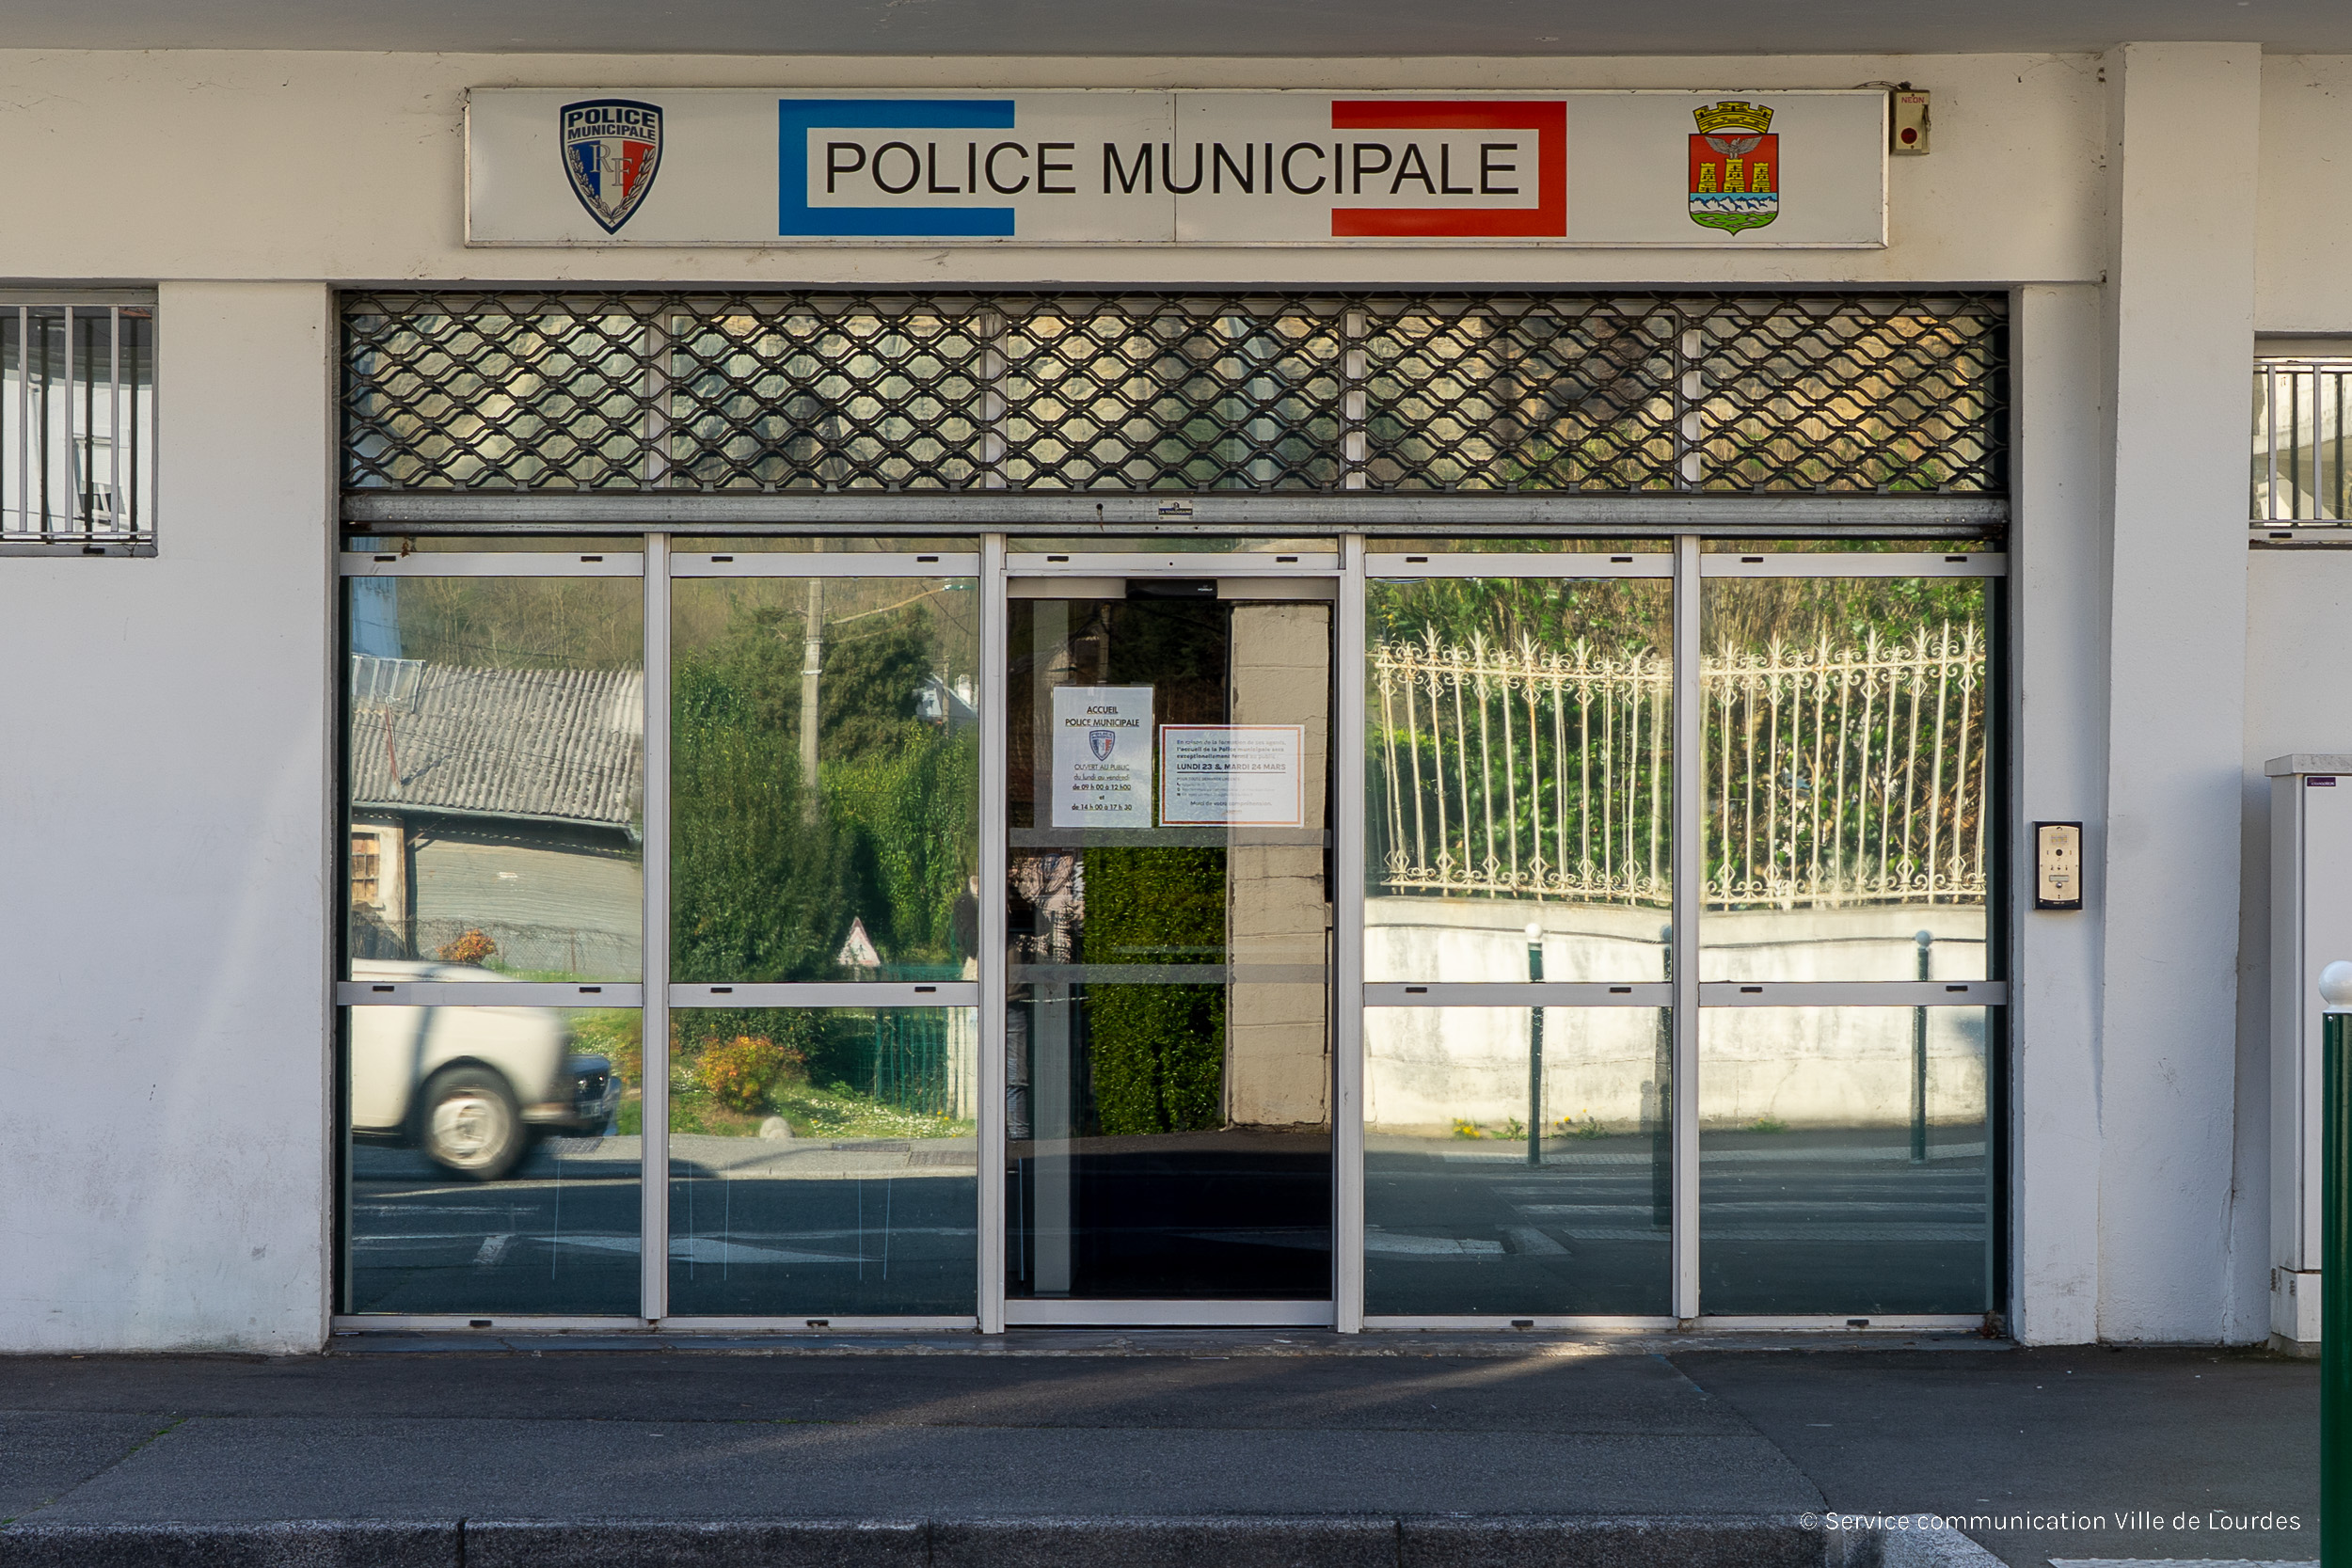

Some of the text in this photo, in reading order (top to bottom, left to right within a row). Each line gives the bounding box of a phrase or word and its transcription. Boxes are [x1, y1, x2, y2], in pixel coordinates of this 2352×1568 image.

[567, 108, 656, 129] POLICE
[567, 124, 657, 140] MUNICIPALE
[828, 142, 1518, 194] POLICE MUNICIPALE
[1065, 719, 1139, 727] POLICE MUNICIPALE
